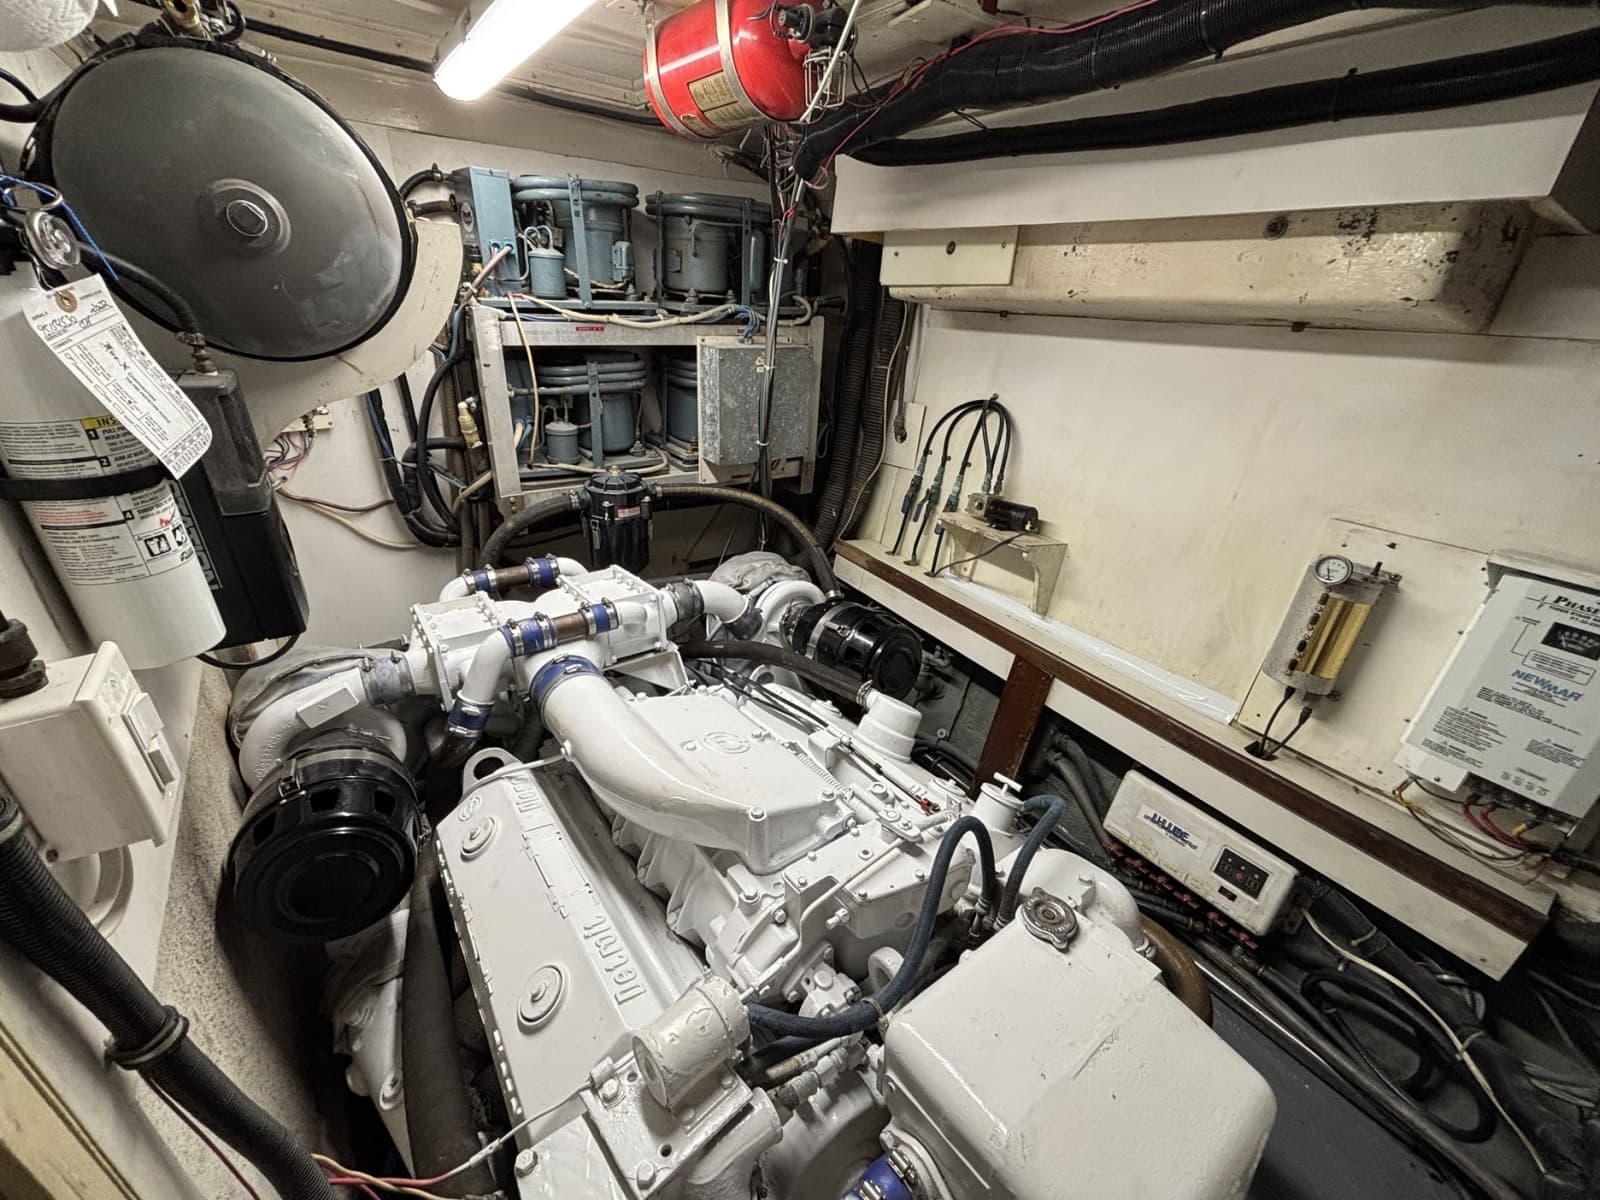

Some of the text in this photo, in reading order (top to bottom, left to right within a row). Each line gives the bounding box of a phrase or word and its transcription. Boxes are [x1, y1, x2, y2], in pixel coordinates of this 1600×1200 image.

[97, 415, 120, 427] INS
[1553, 595, 1600, 615] PHASE
[1512, 669, 1584, 702] NEWMAR
[584, 912, 648, 1005] Detroit
